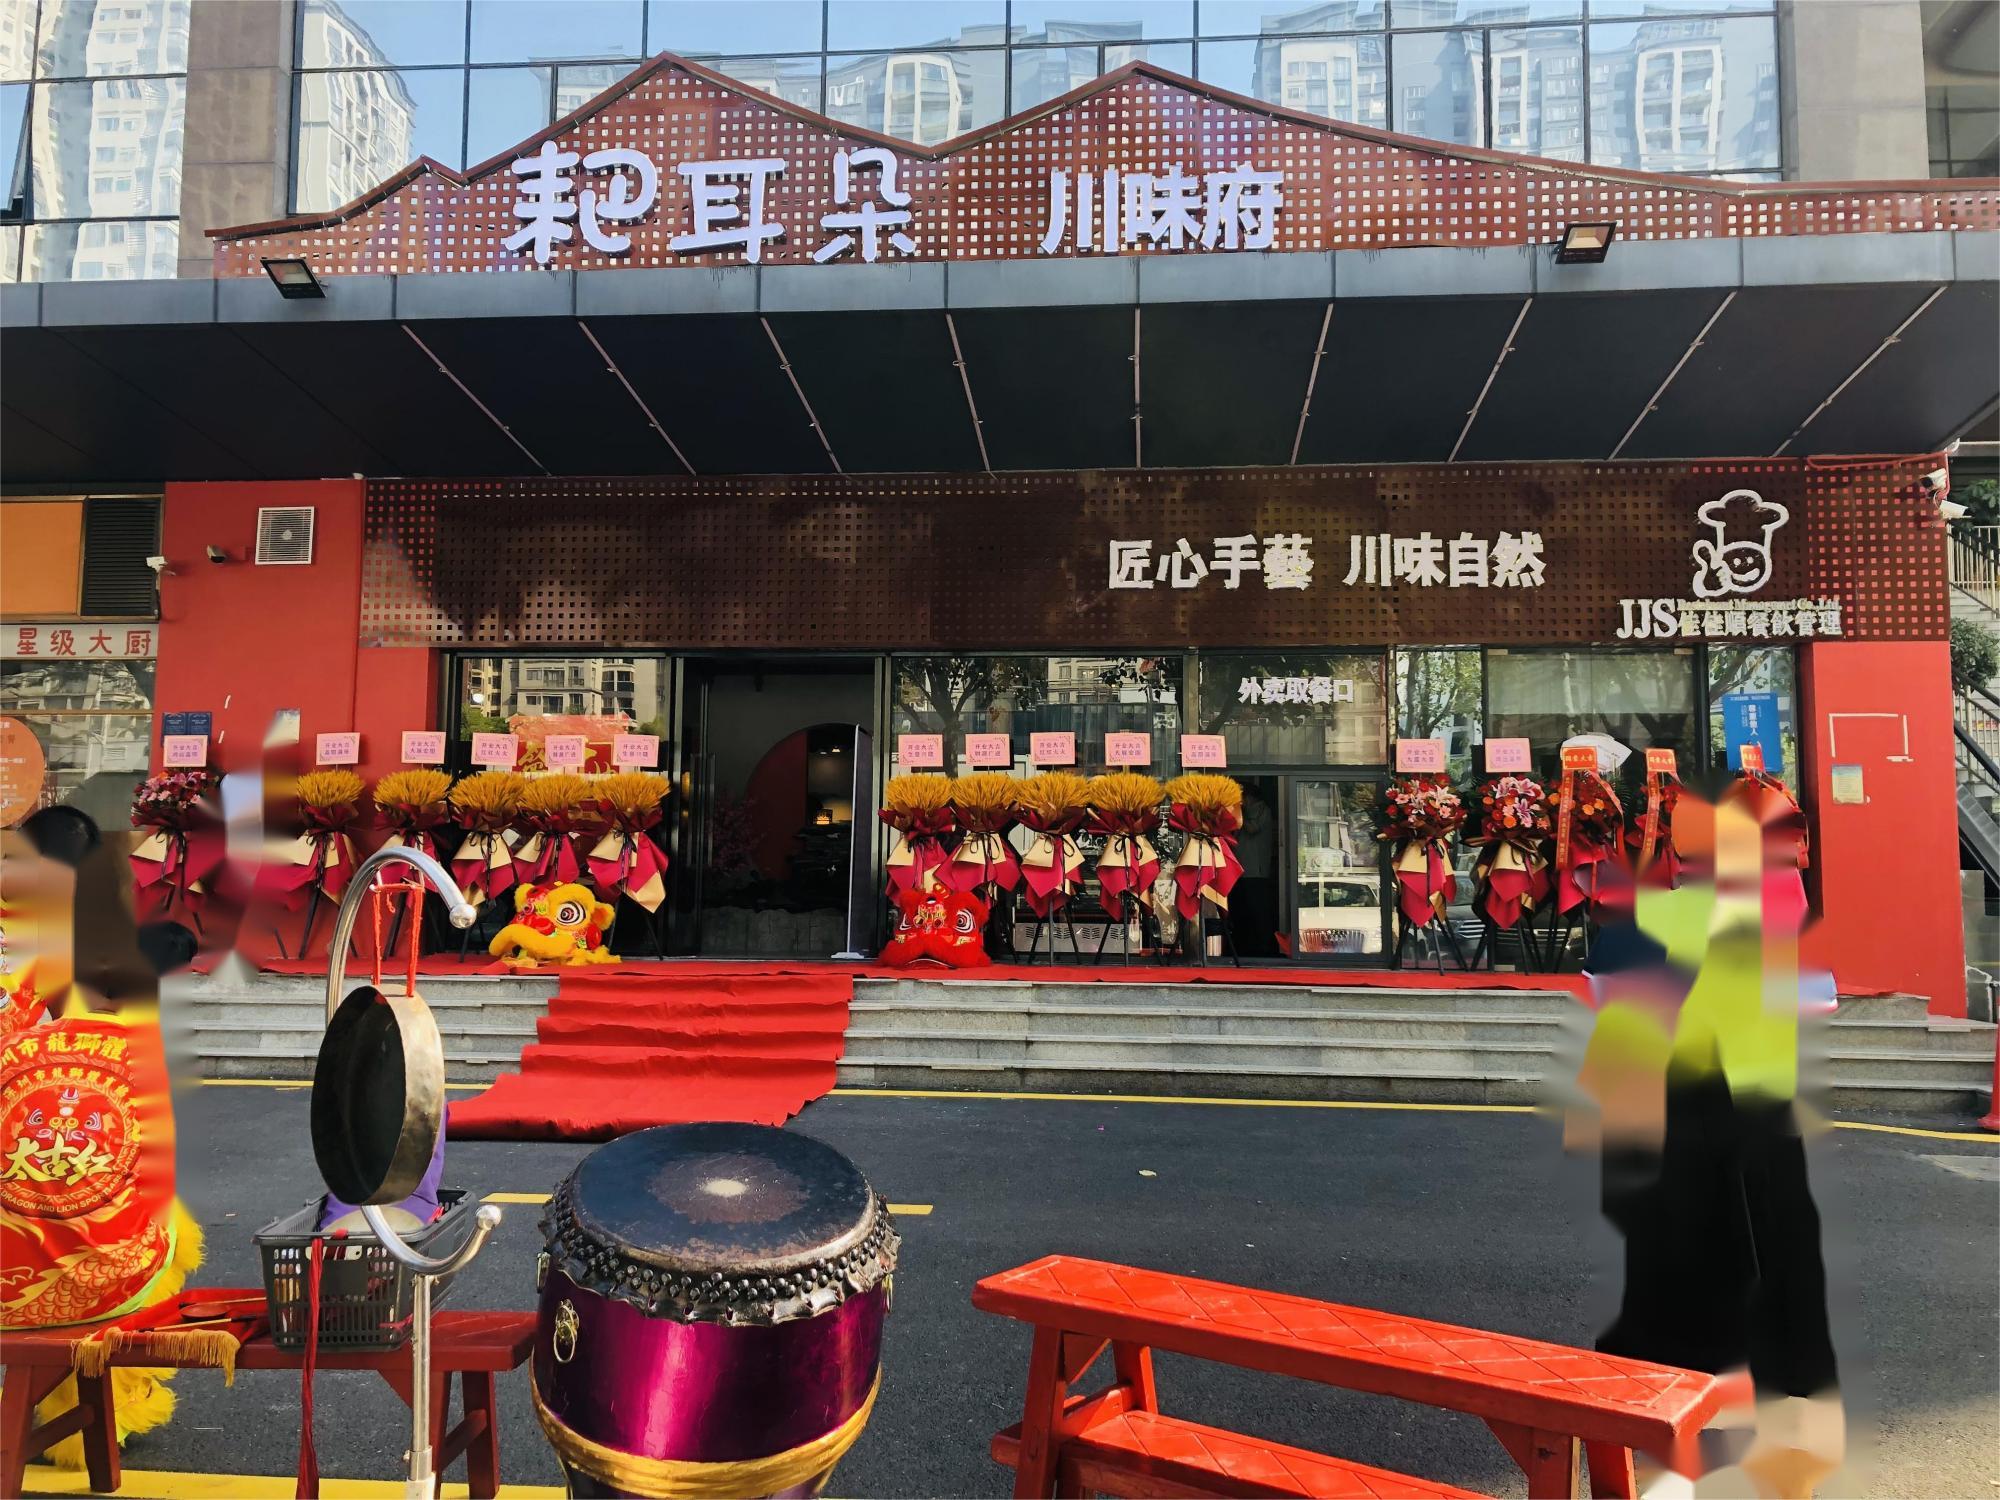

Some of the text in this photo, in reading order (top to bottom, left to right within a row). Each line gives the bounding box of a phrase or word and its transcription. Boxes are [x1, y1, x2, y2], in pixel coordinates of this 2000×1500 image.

[1042, 164, 1284, 255] 川味府
[1109, 532, 1546, 590] 匠心手藝 川味自然
[1616, 598, 1678, 639] JJS
[16, 626, 152, 656] 星级大厨
[1237, 676, 1354, 704] 外卖取餐口
[56, 1203, 79, 1213] LION
